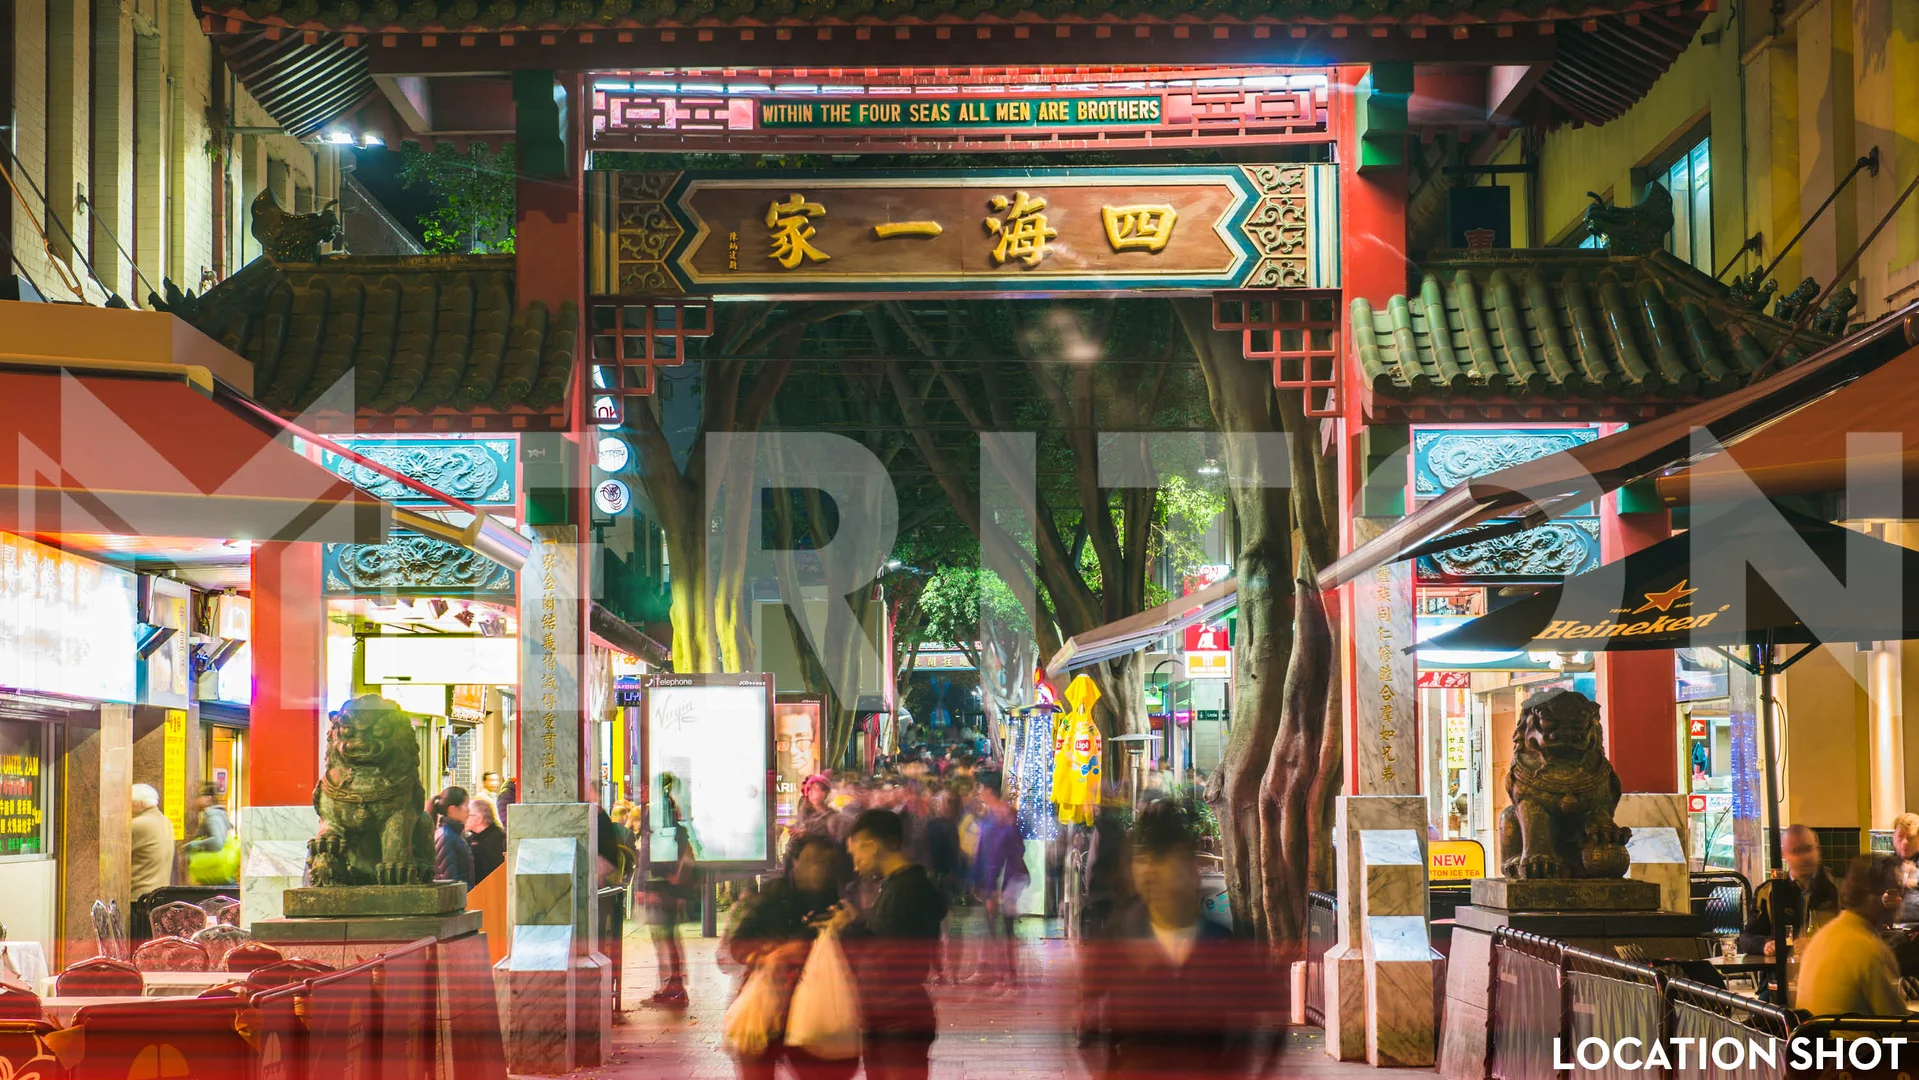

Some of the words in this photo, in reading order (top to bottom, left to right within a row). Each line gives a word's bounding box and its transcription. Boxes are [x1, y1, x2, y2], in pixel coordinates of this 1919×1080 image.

[763, 104, 813, 123] WITHIN
[821, 104, 851, 123] THE
[859, 103, 901, 123] FOUR
[909, 103, 950, 122] SEAS
[958, 102, 989, 122] ALL
[996, 102, 1031, 122] MEN
[1038, 101, 1069, 121] ARE
[1077, 100, 1160, 120] BROTHERS
[1531, 610, 1719, 640] Heineken
[655, 677, 692, 688] Telephone
[24, 757, 39, 776] 2AM
[1433, 854, 1467, 867] NEW
[1450, 869, 1462, 877] ICE
[1465, 869, 1480, 877] TEA
